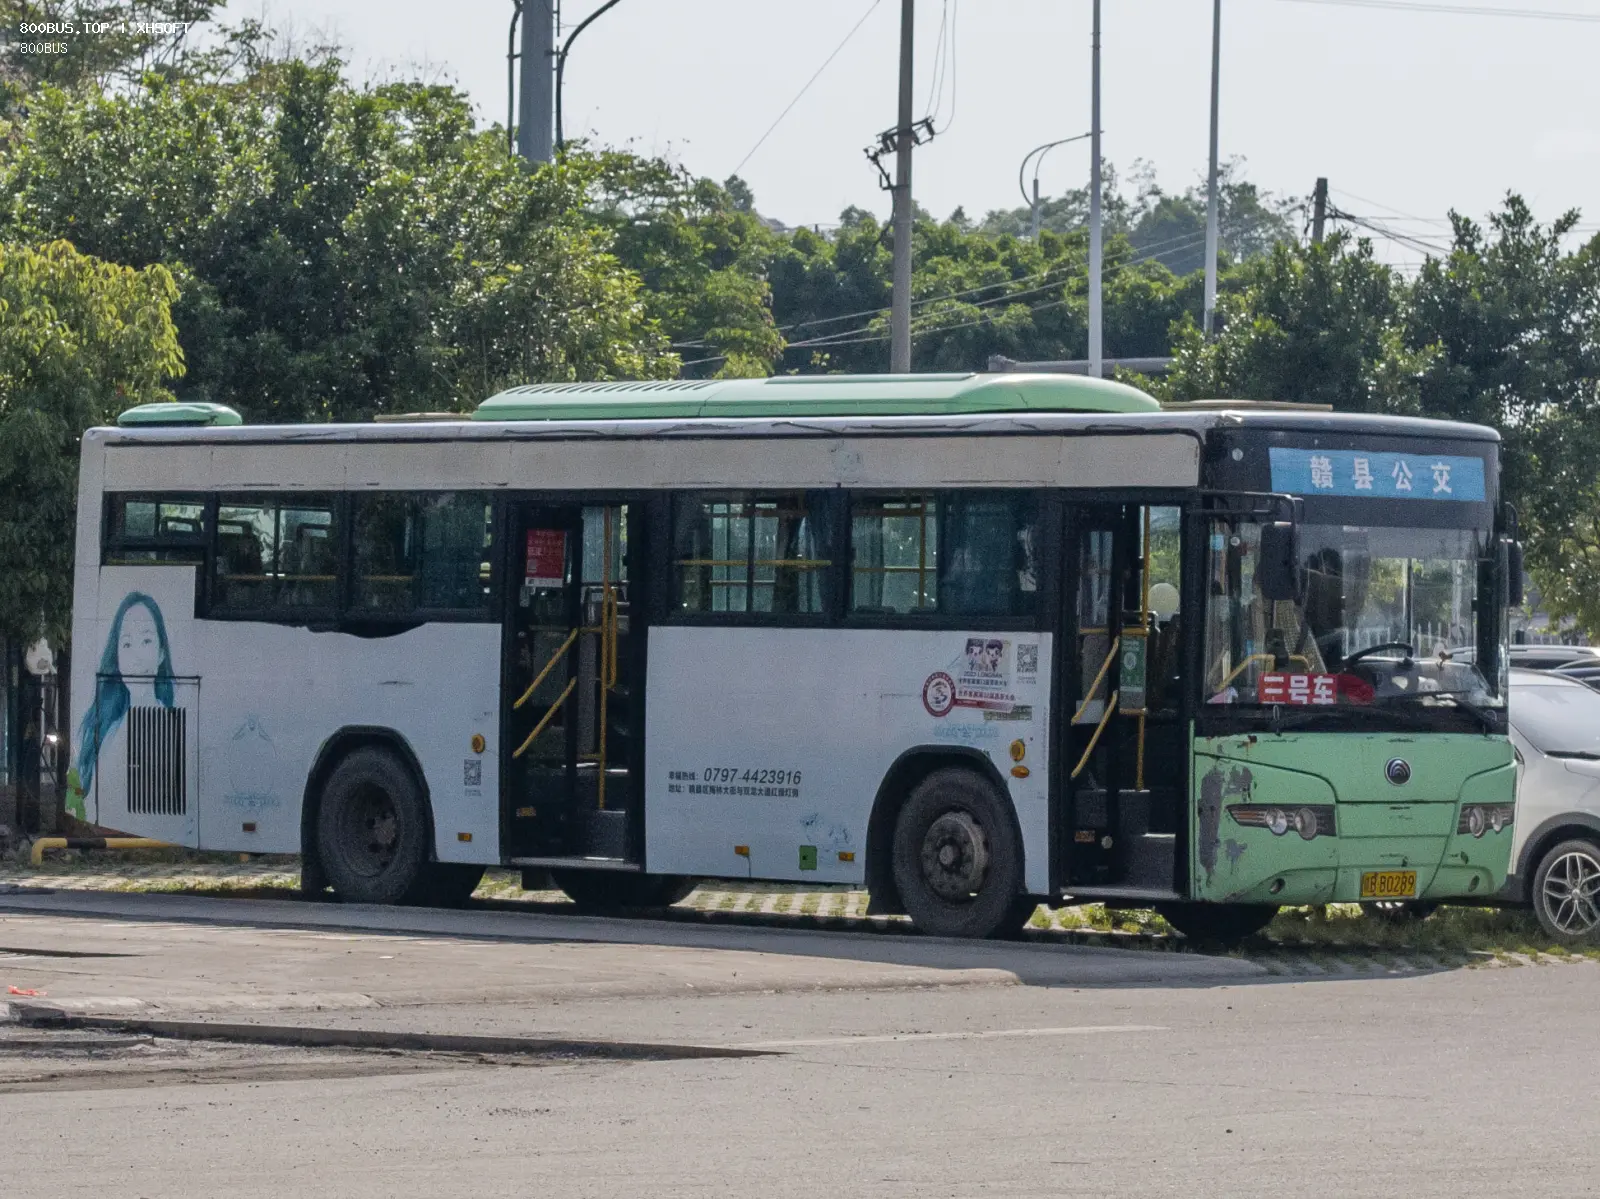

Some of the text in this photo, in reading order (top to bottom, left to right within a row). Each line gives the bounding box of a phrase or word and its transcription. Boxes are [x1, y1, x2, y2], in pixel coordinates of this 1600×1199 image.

[1309, 455, 1452, 494] 赣县公交
[1261, 675, 1335, 705] 三号车
[703, 767, 802, 784] 0797-4423916
